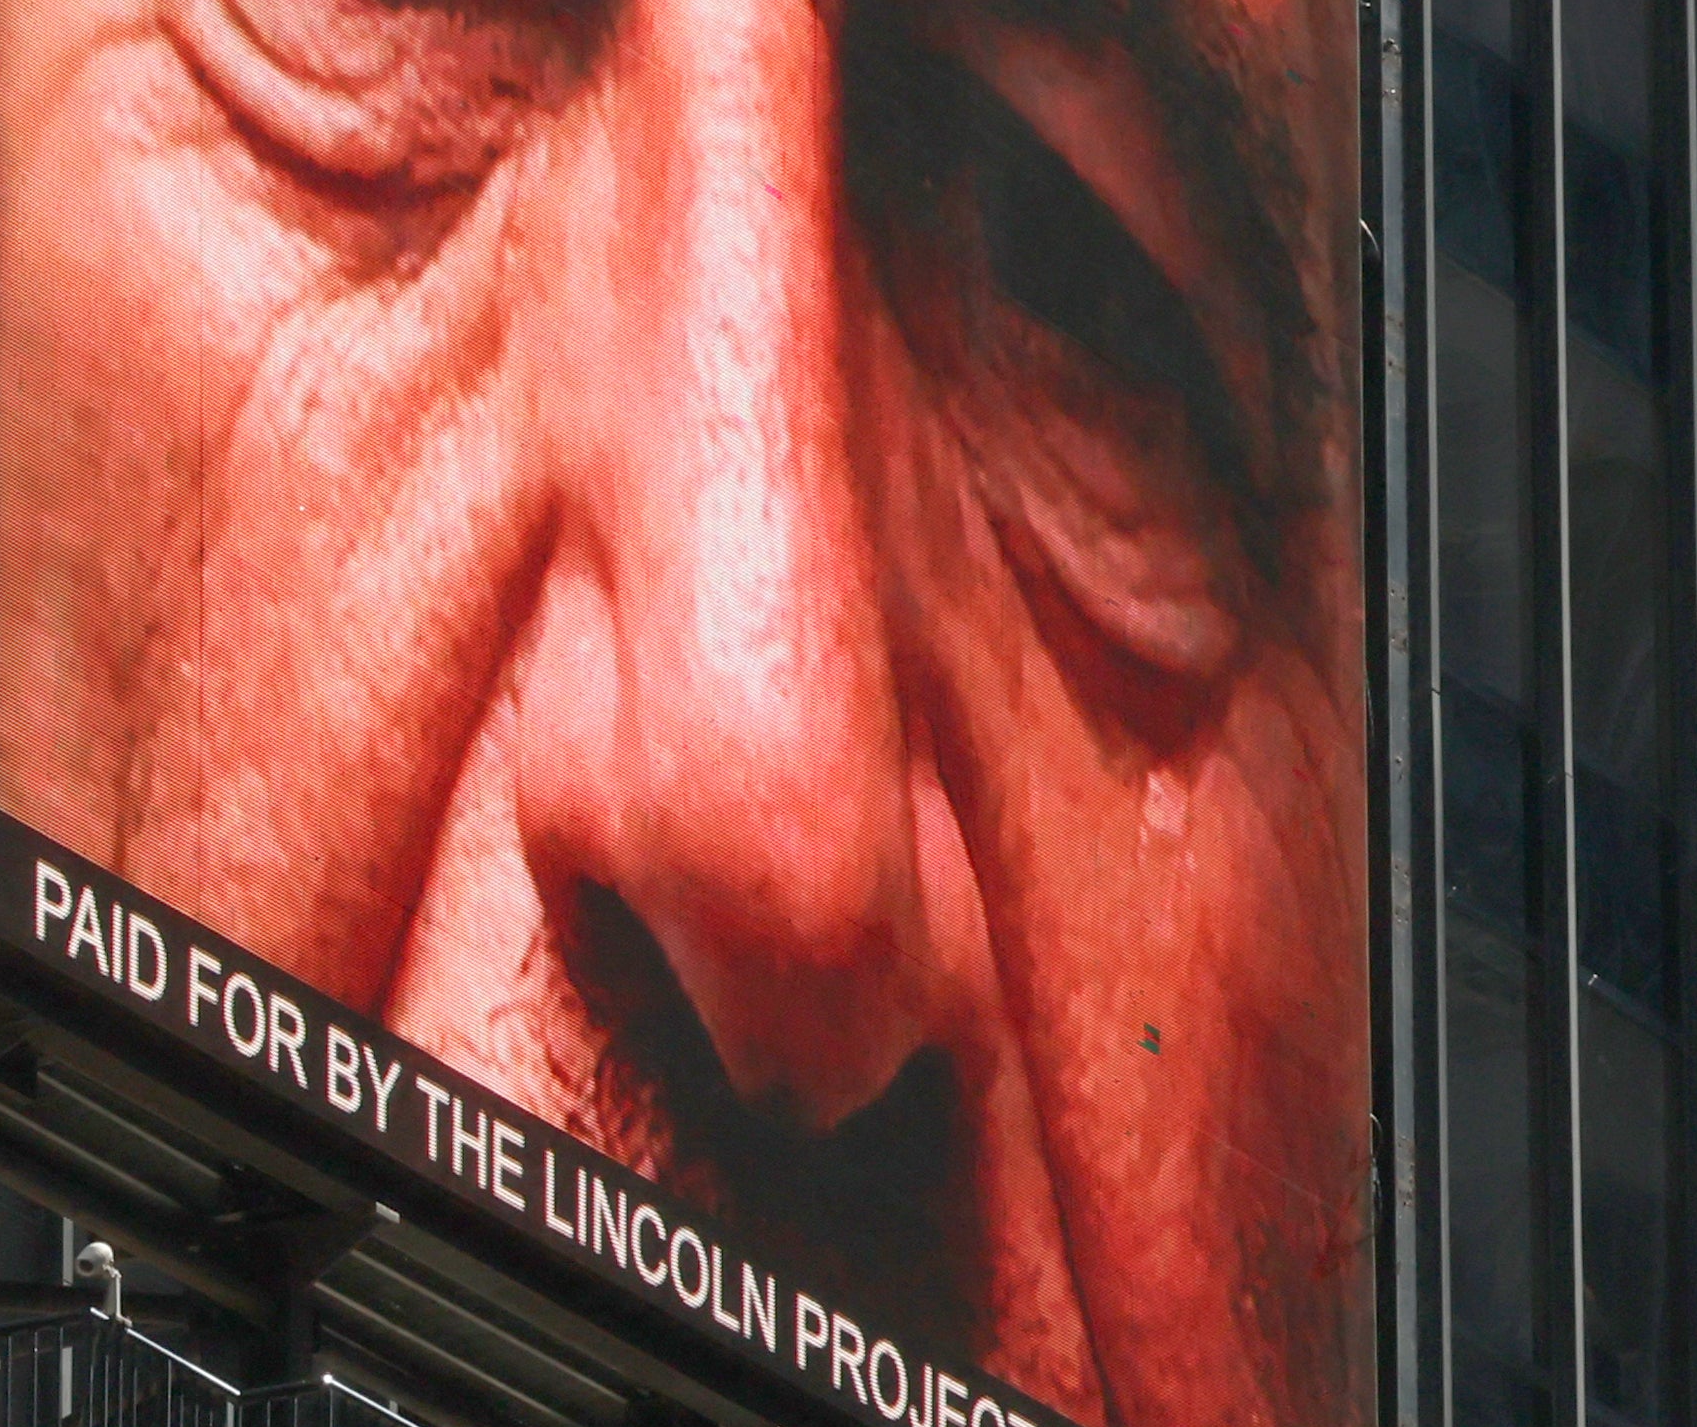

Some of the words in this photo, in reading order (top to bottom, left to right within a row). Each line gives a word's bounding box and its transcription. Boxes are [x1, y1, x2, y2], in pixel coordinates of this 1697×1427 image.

[36, 859, 167, 1001] PAID
[189, 947, 307, 1088] FOR
[328, 1024, 401, 1132] BY
[416, 1075, 525, 1211] THE
[546, 1151, 775, 1352] LINCOLN
